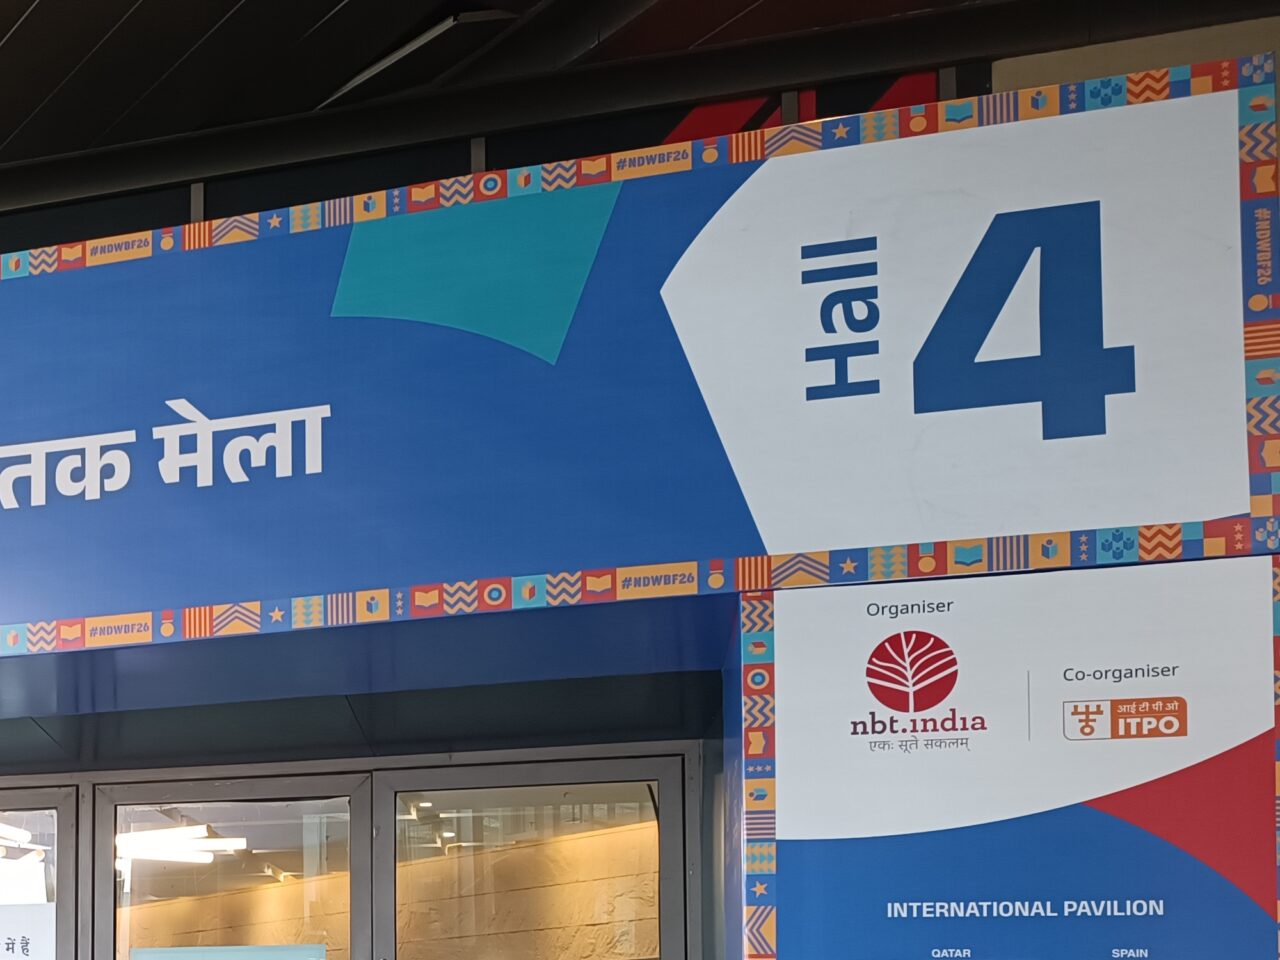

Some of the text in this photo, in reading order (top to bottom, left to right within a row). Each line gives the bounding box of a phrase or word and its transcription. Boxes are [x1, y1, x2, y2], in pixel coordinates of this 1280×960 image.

[615, 149, 689, 170] #NDWBF26
[90, 238, 150, 256] #NDWBF26
[1254, 208, 1272, 285] #NDWBF26
[801, 236, 880, 401] Hall
[913, 200, 1136, 440] 4
[152, 398, 331, 487] मेला
[621, 572, 695, 590] #NDWBF26
[866, 599, 954, 620] Organiser
[89, 622, 149, 638] #NDWBF26
[1063, 663, 1179, 683] Co-organiser
[1117, 701, 1180, 714] आई टी पी ओ
[850, 708, 987, 735] nbt.india
[1118, 716, 1180, 735] ITPO
[898, 735, 920, 753] सूते
[923, 737, 971, 751] सकलम्
[887, 899, 1164, 918] INTERNATIONAL PAVILION
[5, 937, 16, 954] में
[20, 936, 30, 957] हैं
[931, 949, 971, 959] QATAR
[1111, 948, 1148, 958] SPAIN
